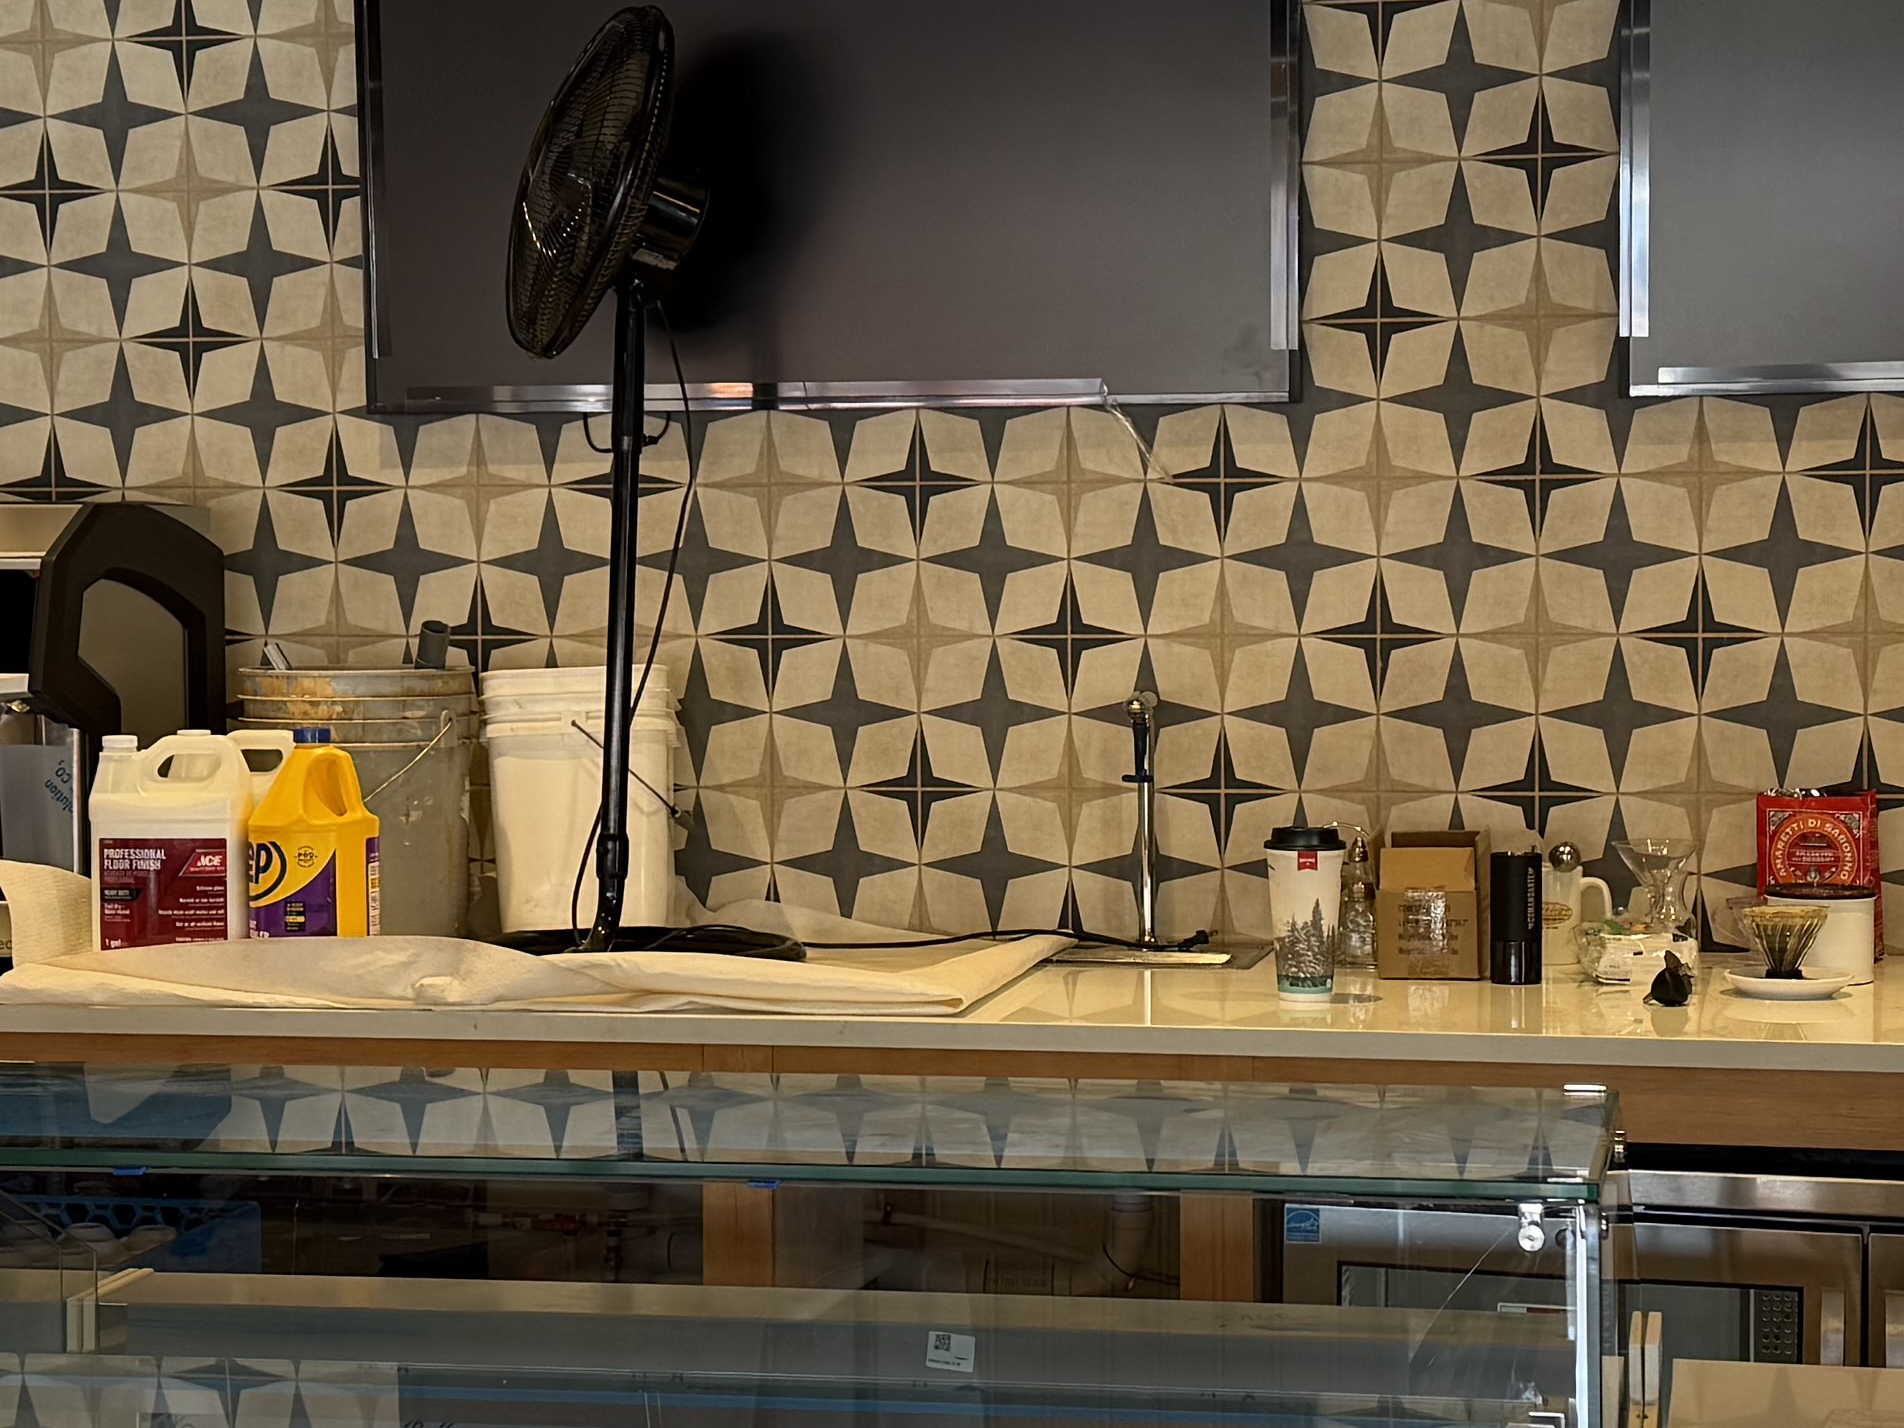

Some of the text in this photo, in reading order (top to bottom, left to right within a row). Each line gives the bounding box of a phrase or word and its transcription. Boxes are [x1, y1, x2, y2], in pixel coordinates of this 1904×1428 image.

[103, 848, 167, 860] PROFESSIONAL
[103, 859, 162, 871] FLOOR FINISH
[196, 854, 224, 867] ACE
